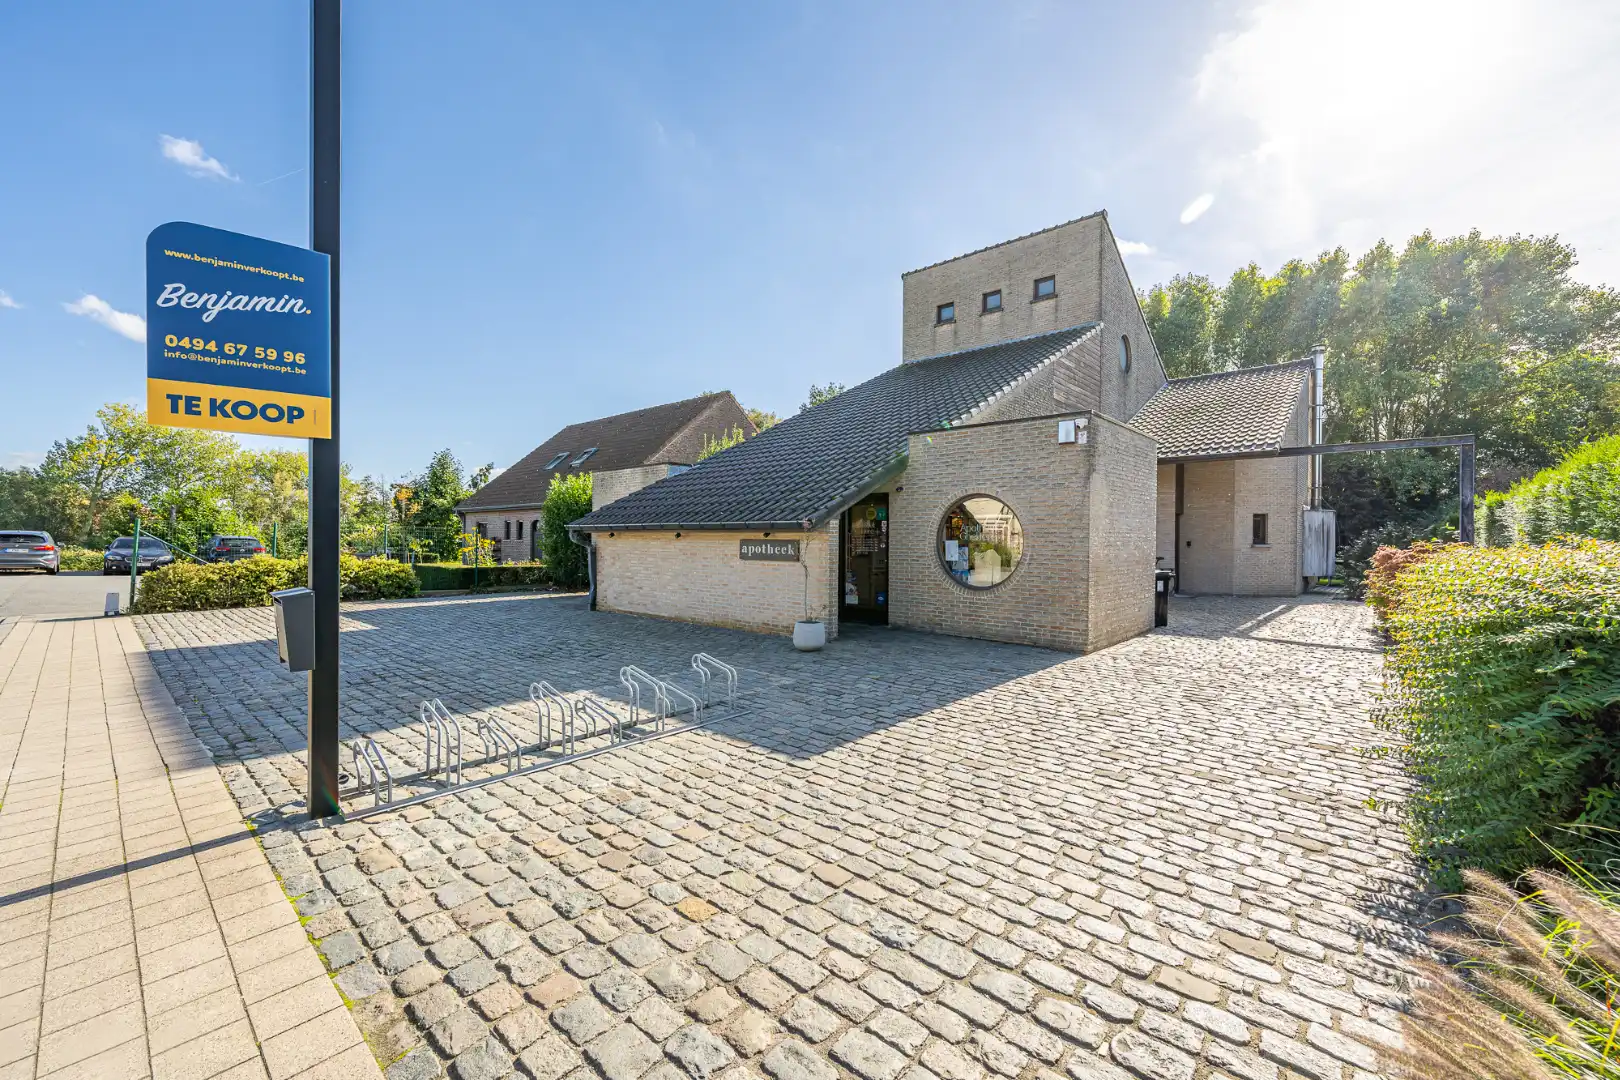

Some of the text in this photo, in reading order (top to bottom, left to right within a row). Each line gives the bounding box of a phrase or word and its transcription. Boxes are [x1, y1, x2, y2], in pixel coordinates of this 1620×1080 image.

[164, 248, 305, 283] www.benjaminverkoopt.be
[156, 282, 312, 323] Benjamin.
[164, 334, 306, 365] 0494 67 59 96
[164, 349, 307, 375] info@benjaminverkoopt.be
[166, 393, 202, 416] TE
[209, 398, 305, 425] KOOP
[741, 543, 795, 557] apotheek
